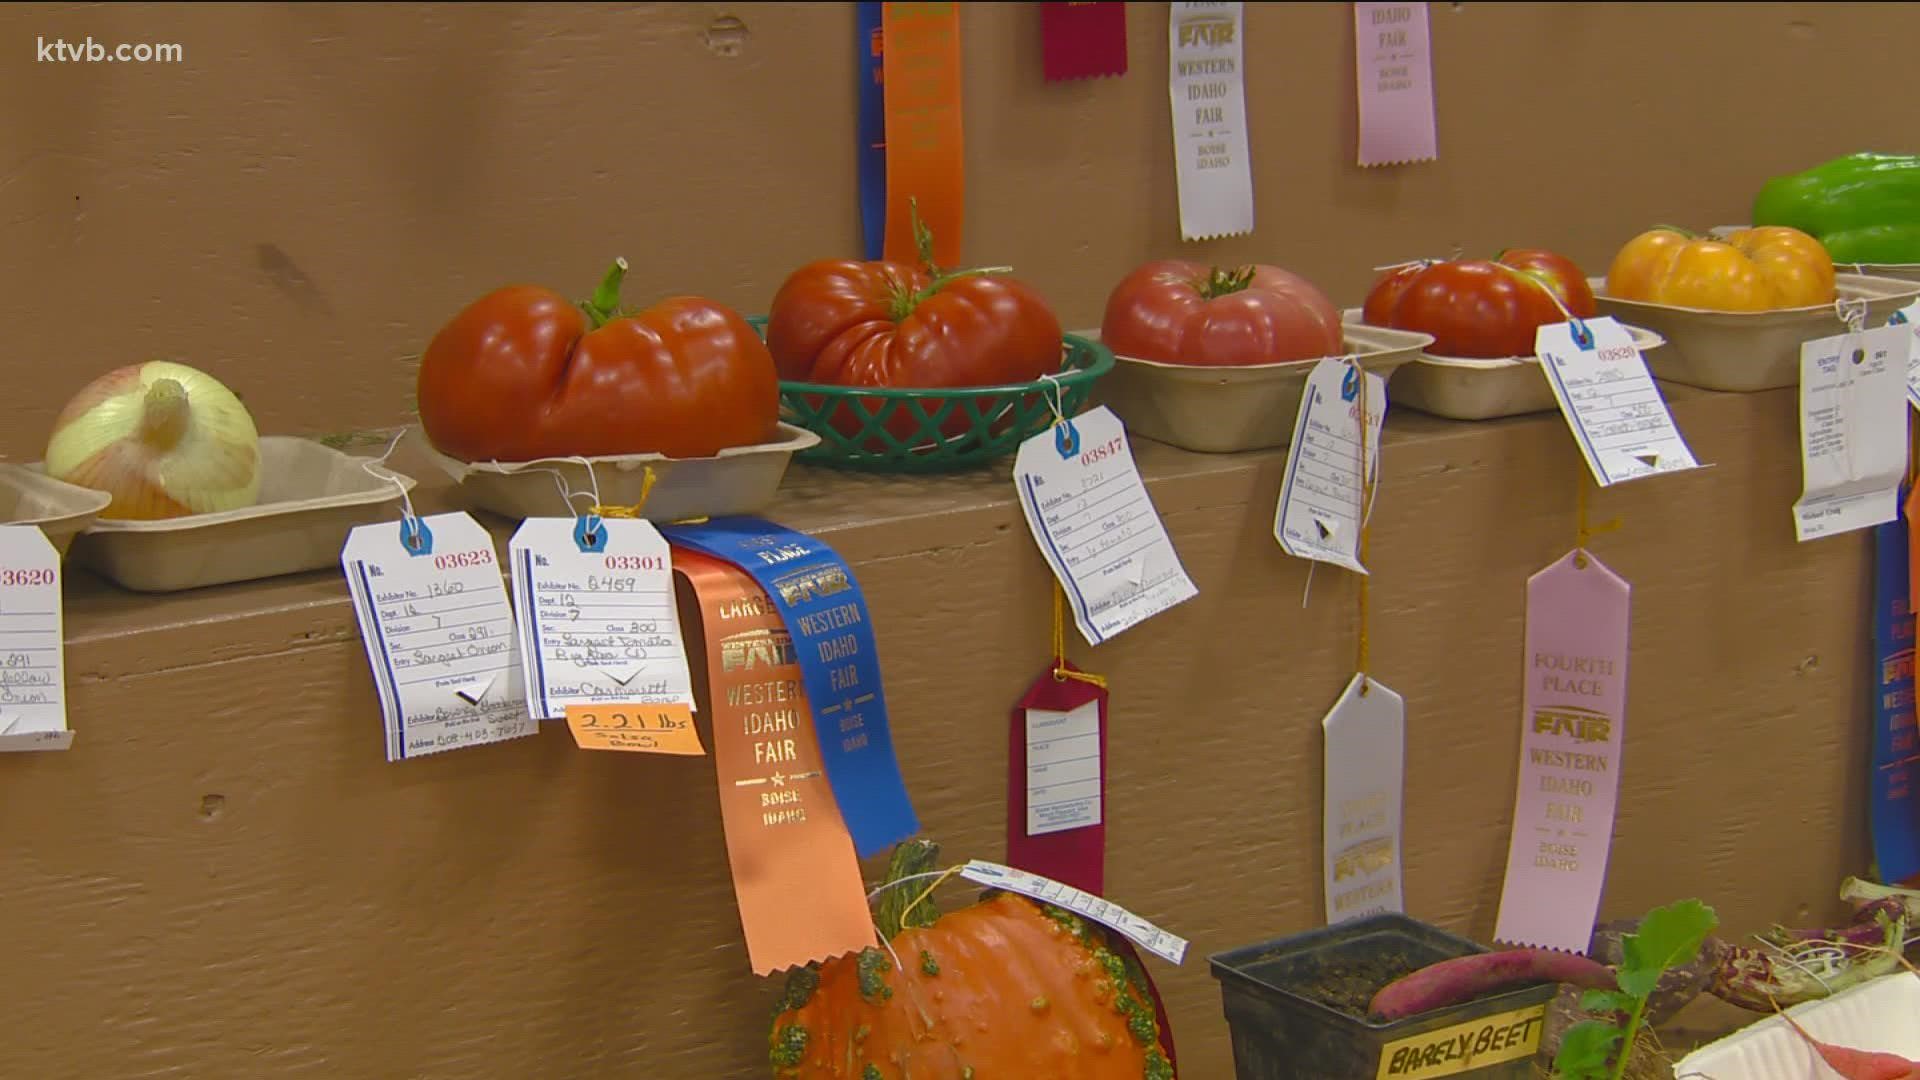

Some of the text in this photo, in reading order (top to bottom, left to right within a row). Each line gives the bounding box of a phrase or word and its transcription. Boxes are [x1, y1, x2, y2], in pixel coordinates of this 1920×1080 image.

[1371, 7, 1412, 25] IDAHO
[1379, 31, 1408, 48] FAIR
[1178, 57, 1235, 76] WESTERN
[1187, 81, 1227, 100] IDAHO
[1195, 106, 1223, 124] FAIR
[1197, 156, 1230, 170] IDAHO
[1080, 437, 1124, 467] 03847
[433, 549, 493, 571] 03623
[535, 553, 665, 571] No. 03301
[0, 569, 54, 586] 3620
[606, 624, 625, 632] Class
[796, 602, 861, 637] WESTERN
[543, 637, 561, 647] Entry
[817, 633, 859, 664] IDAHO
[394, 657, 411, 667] Entry
[1534, 652, 1614, 675] FOURTH
[830, 664, 860, 692] FAIR
[1542, 675, 1604, 697] PLACE
[727, 680, 800, 706] WESTER
[581, 713, 688, 730] 2.21 lbs
[743, 708, 800, 736] IDAHO
[1533, 709, 1612, 742] FAIR
[754, 738, 796, 765] FAIR
[1529, 747, 1608, 772] WESTERN
[1539, 775, 1593, 797] IDAHO
[760, 789, 803, 807] BOISE
[763, 808, 807, 826] IDAHO
[1544, 801, 1585, 822] FAIR
[1538, 842, 1578, 857] BOISE
[1535, 855, 1579, 873] IDAHO
[1388, 1016, 1545, 1075] BARELY BEET
